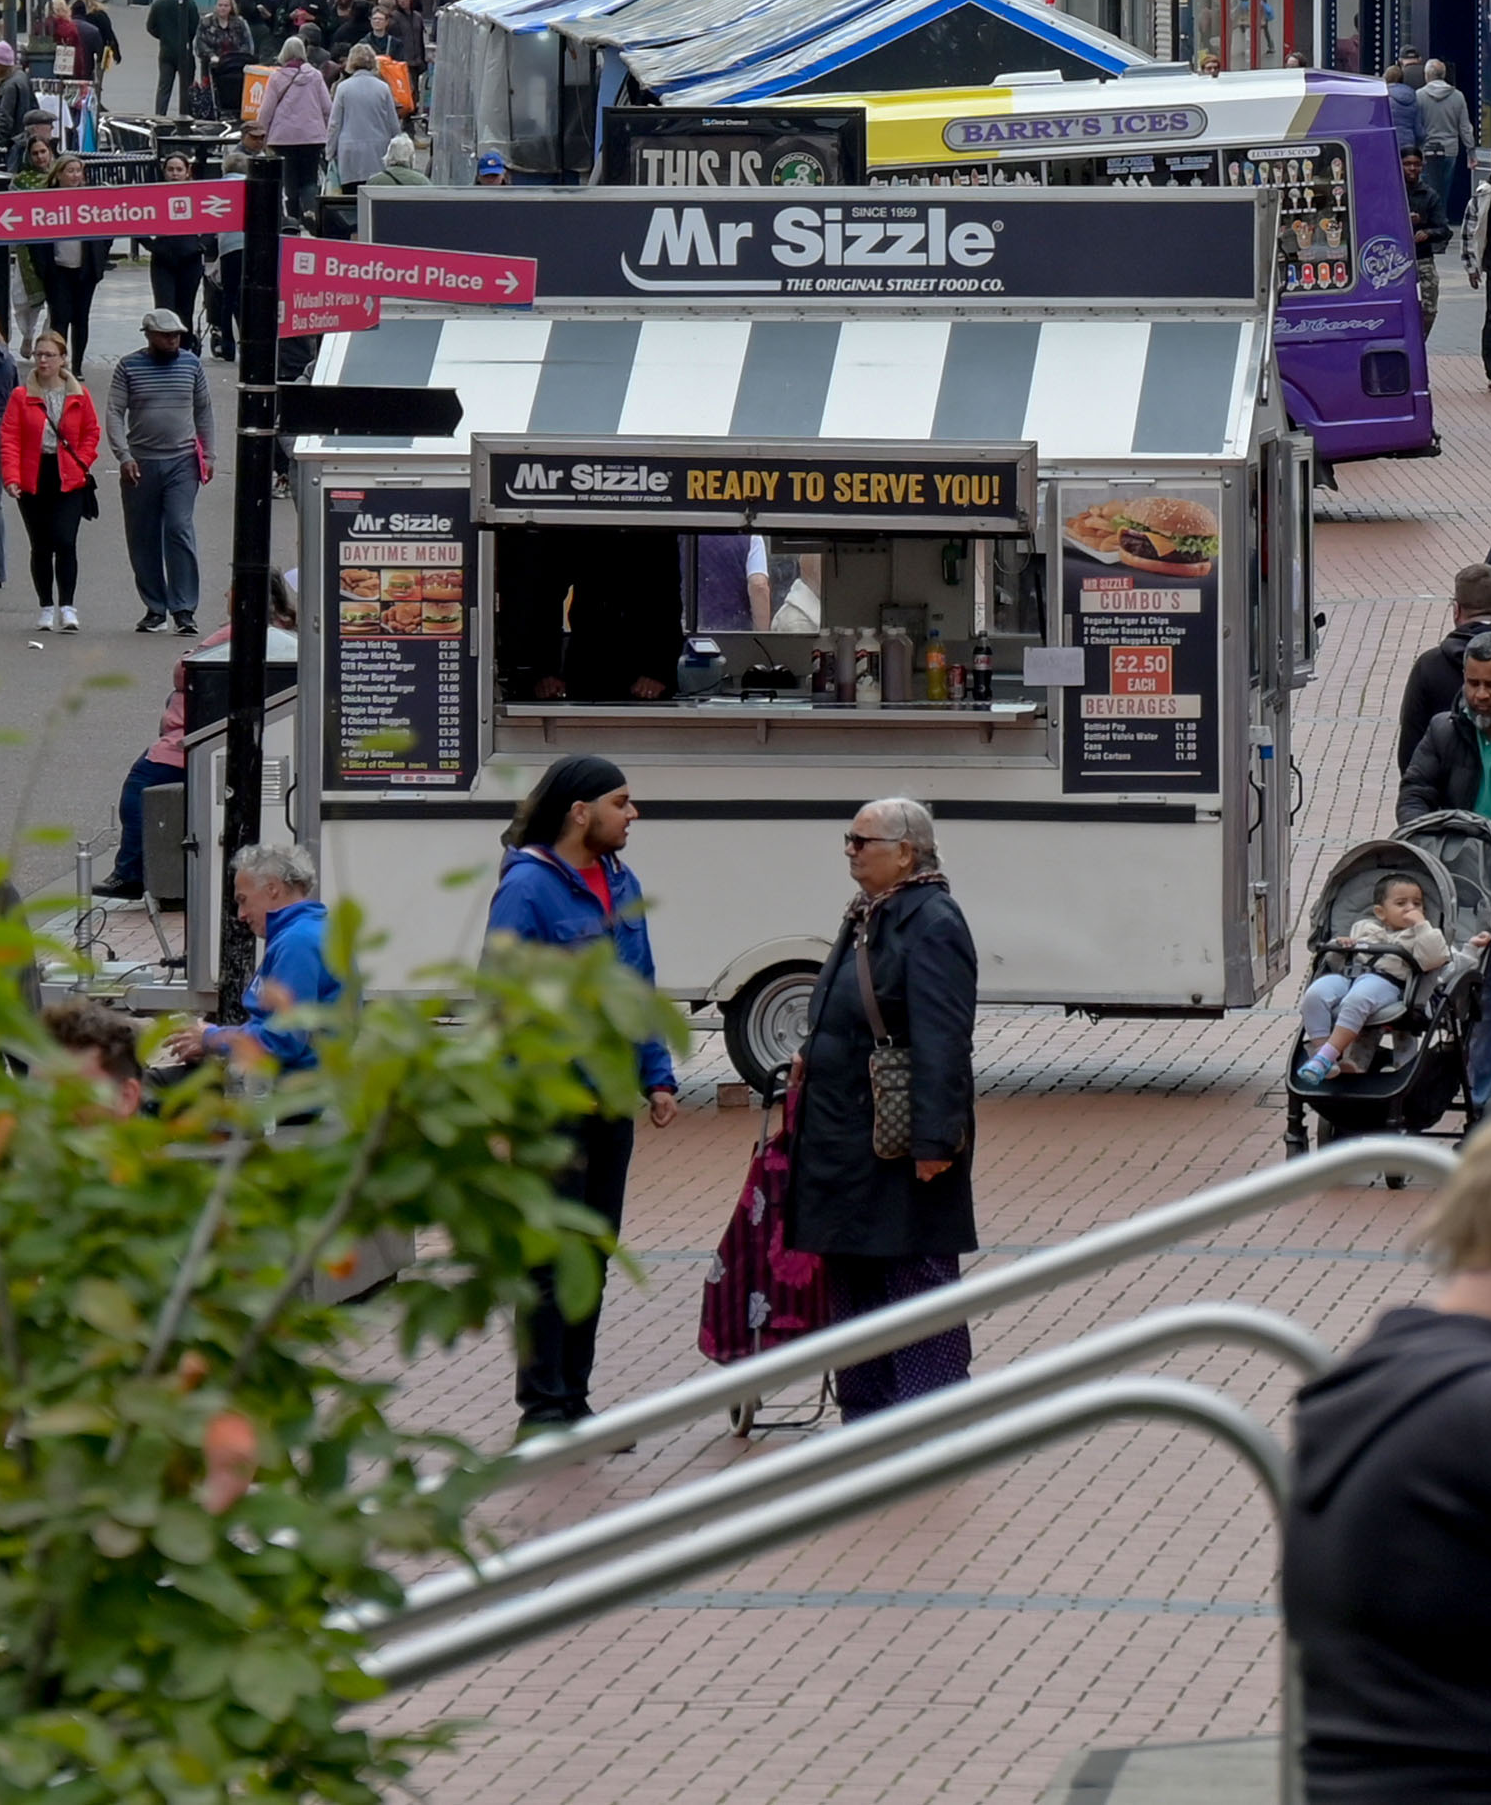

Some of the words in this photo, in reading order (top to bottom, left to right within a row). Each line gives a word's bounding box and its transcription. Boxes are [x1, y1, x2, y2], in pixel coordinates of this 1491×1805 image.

[962, 117, 1101, 144] BARRY'S
[1112, 112, 1189, 133] ICES
[1250, 148, 1286, 159] LUXURY
[1287, 147, 1318, 157] SCOOP
[642, 149, 719, 186] THIS
[729, 150, 762, 186] IS
[31, 205, 71, 227] Rail
[77, 203, 157, 224] Station
[852, 208, 887, 217] SINCE
[891, 207, 917, 217] 1959
[639, 207, 752, 265] Mr
[771, 207, 996, 267] Sizzle
[325, 257, 418, 284] Bradford
[426, 267, 483, 290] Place
[786, 279, 813, 291] THE
[816, 279, 875, 291] ORIGINAL
[885, 279, 937, 291] STREET
[939, 279, 978, 291] FOOD
[981, 279, 1005, 291] CO.
[293, 291, 323, 309] Walsall
[292, 314, 307, 330] Bus
[309, 311, 339, 328] Station
[513, 463, 563, 491] Mr
[570, 464, 669, 492] Sizzle
[686, 470, 779, 501] READY
[789, 472, 824, 502] TO
[833, 473, 922, 504] SERVE
[933, 475, 1000, 506] YOU!
[353, 514, 385, 531] Mr
[389, 514, 451, 531] Sizzle
[344, 546, 407, 561] DAYTIME
[416, 546, 456, 561] MENU
[1084, 579, 1098, 590] MR
[1100, 578, 1129, 589] SIZZLE
[1101, 593, 1180, 609] COMBO'S
[1115, 655, 1167, 672] £2.50
[1128, 678, 1156, 691] EACH
[1086, 698, 1177, 714] BEVERAGES
